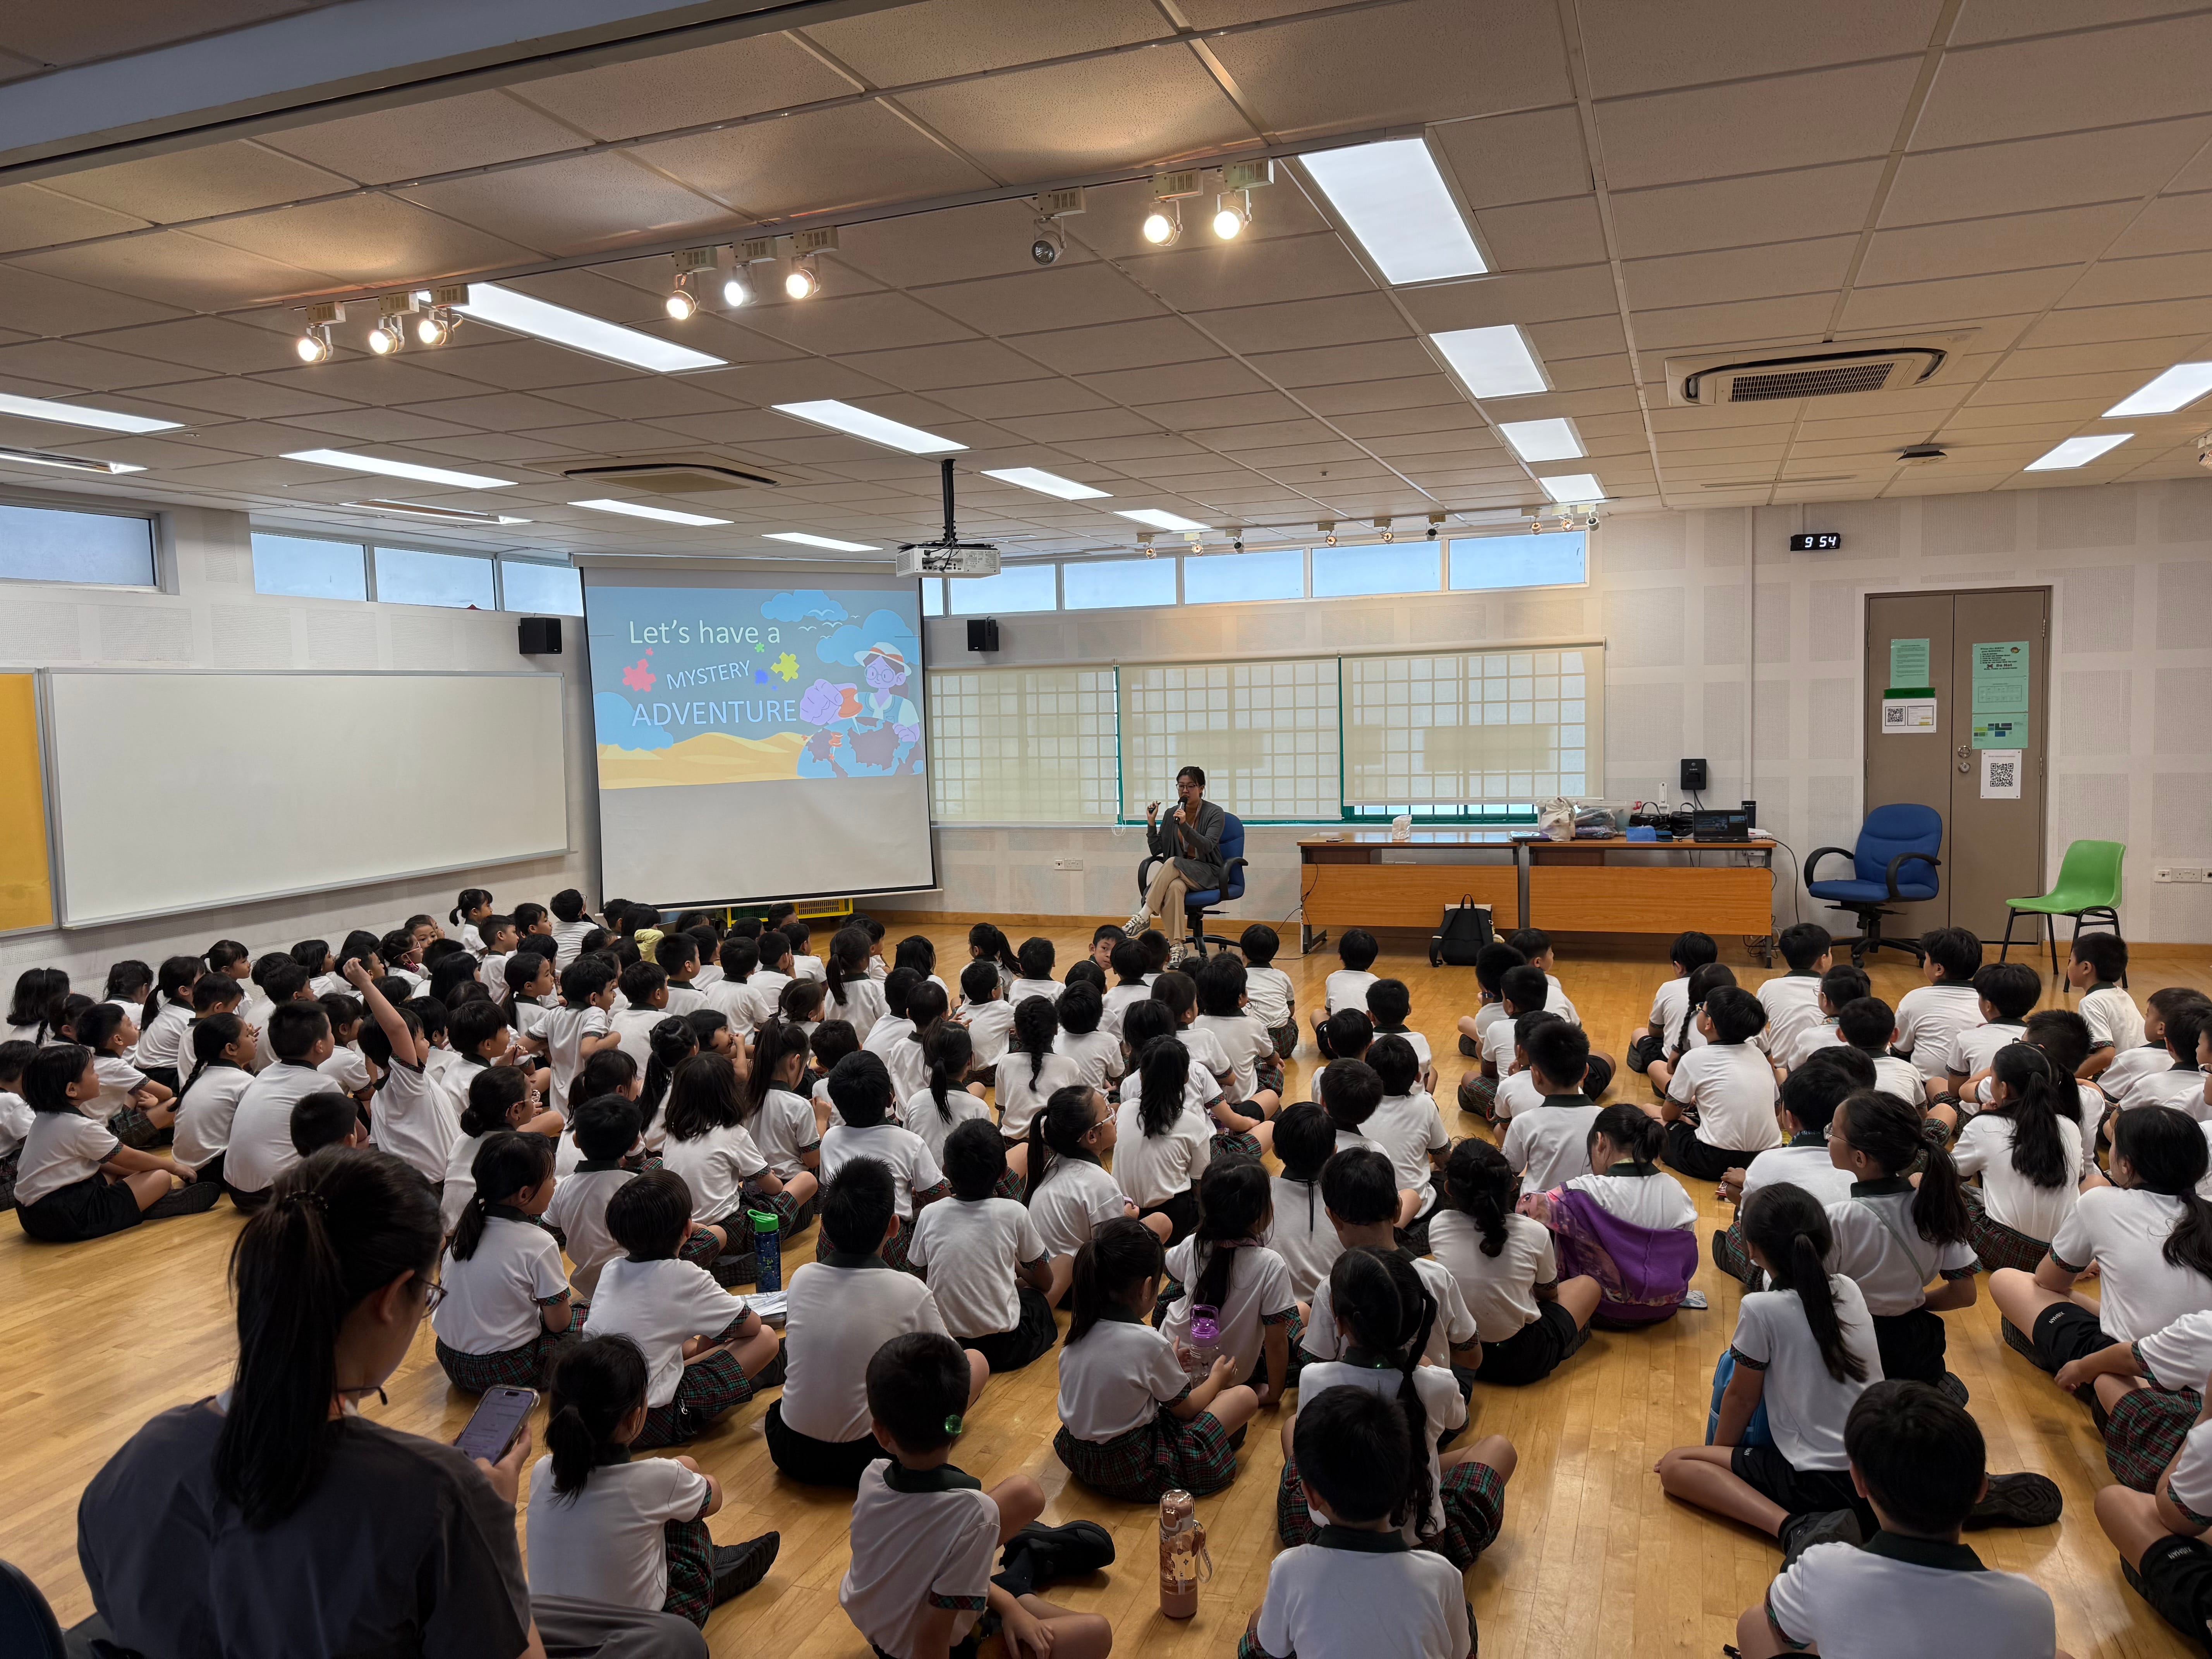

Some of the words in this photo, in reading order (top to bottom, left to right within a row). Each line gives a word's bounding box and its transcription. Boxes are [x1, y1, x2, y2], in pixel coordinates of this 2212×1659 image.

[1805, 537, 1813, 548] 9
[1819, 536, 1836, 547] 54
[699, 620, 758, 644] have
[768, 627, 780, 644] a
[666, 660, 750, 690] MYSTERY
[632, 700, 797, 726] ADVENTURE
[2049, 1311, 2065, 1324] XISHAN
